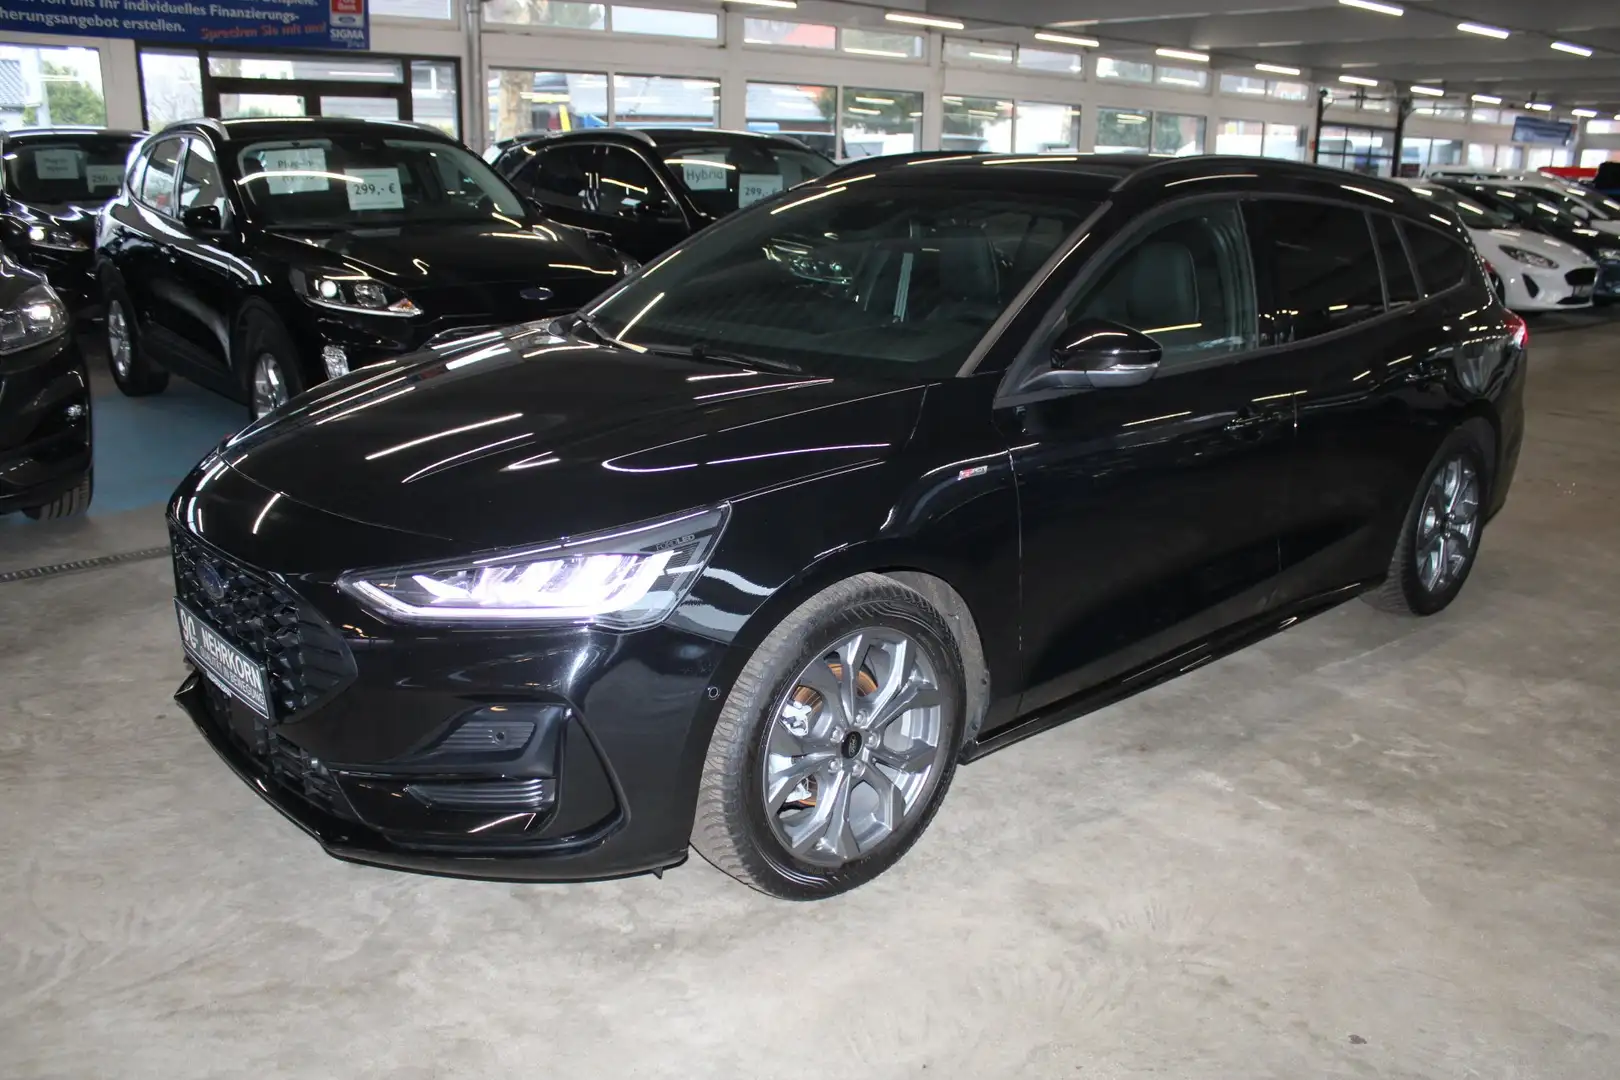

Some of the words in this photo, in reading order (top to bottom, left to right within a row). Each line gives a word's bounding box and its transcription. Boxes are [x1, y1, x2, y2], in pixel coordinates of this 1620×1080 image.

[124, 0, 206, 17] individuelles
[209, 4, 299, 24] Finanzierungs-
[123, 18, 186, 33] erstellen.
[330, 28, 365, 40] SIGMA
[201, 627, 263, 693] NEHRKORN
[229, 671, 265, 705] BEWEGUNG
